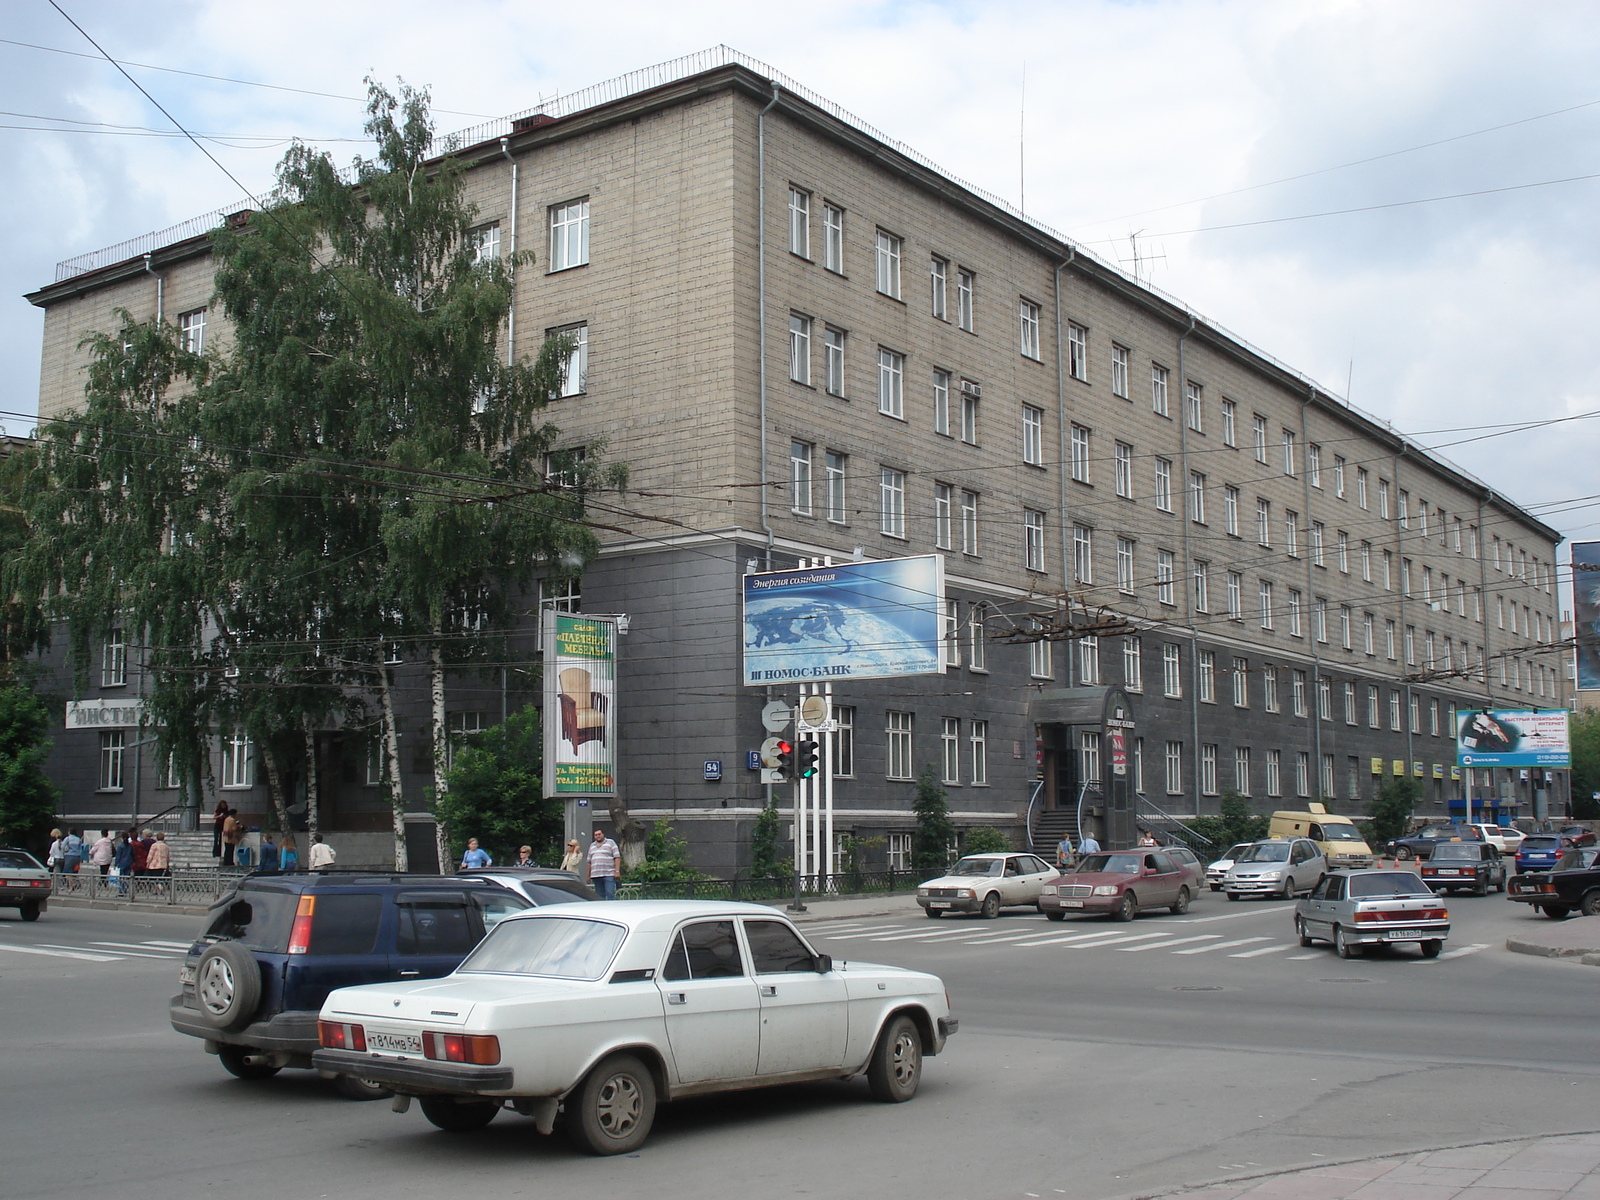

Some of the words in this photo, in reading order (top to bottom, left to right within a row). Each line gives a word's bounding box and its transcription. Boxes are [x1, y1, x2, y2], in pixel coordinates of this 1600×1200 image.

[752, 579, 788, 589] Энергия
[789, 573, 836, 585] созидания
[753, 753, 758, 761] 9
[706, 763, 717, 771] 54
[371, 1034, 407, 1050] Т814МВ
[407, 1036, 417, 1048] 54
